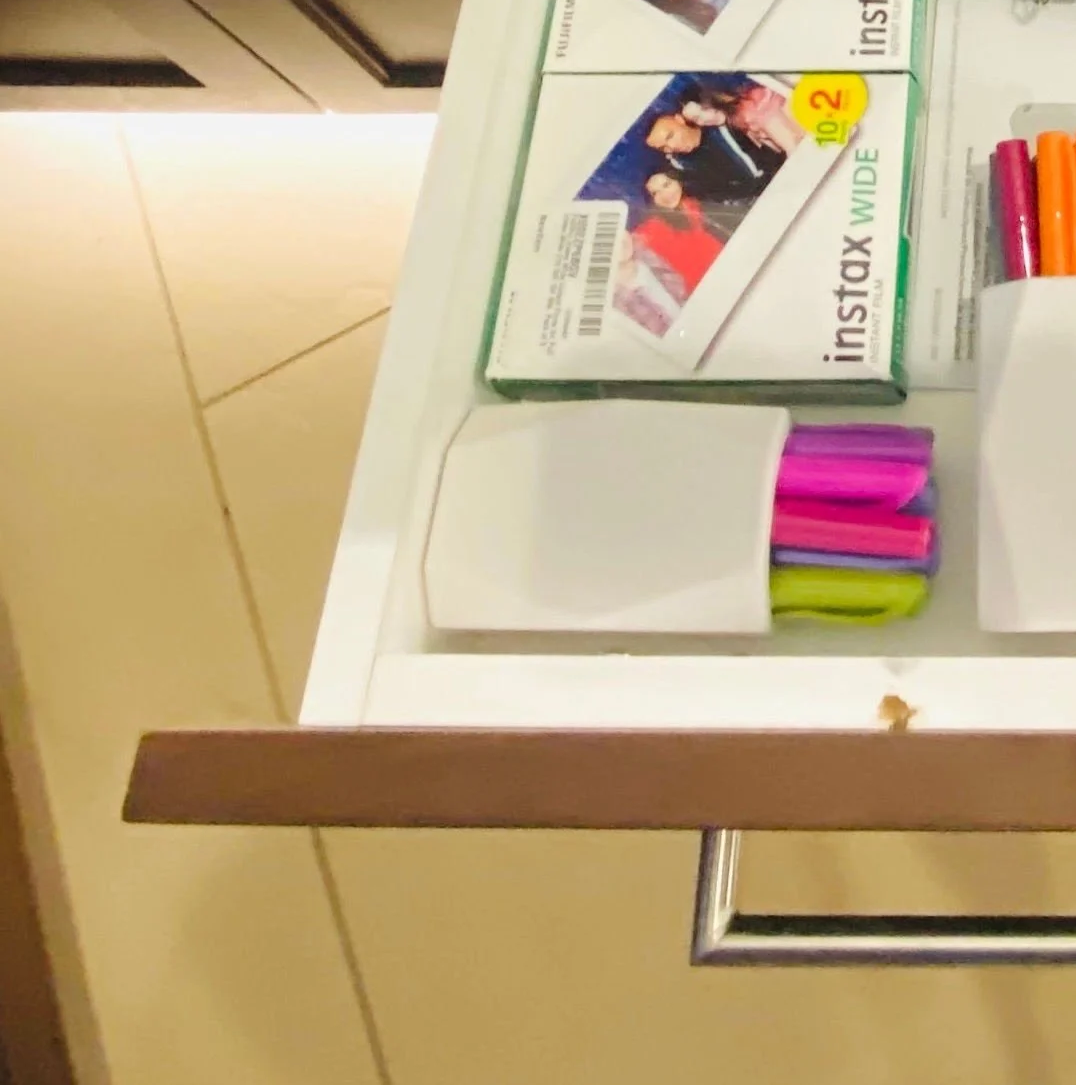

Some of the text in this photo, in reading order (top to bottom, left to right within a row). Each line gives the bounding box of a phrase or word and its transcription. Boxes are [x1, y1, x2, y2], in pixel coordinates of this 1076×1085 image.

[824, 147, 879, 363] instax WIDE
[871, 279, 884, 364] INSTANT FILM
